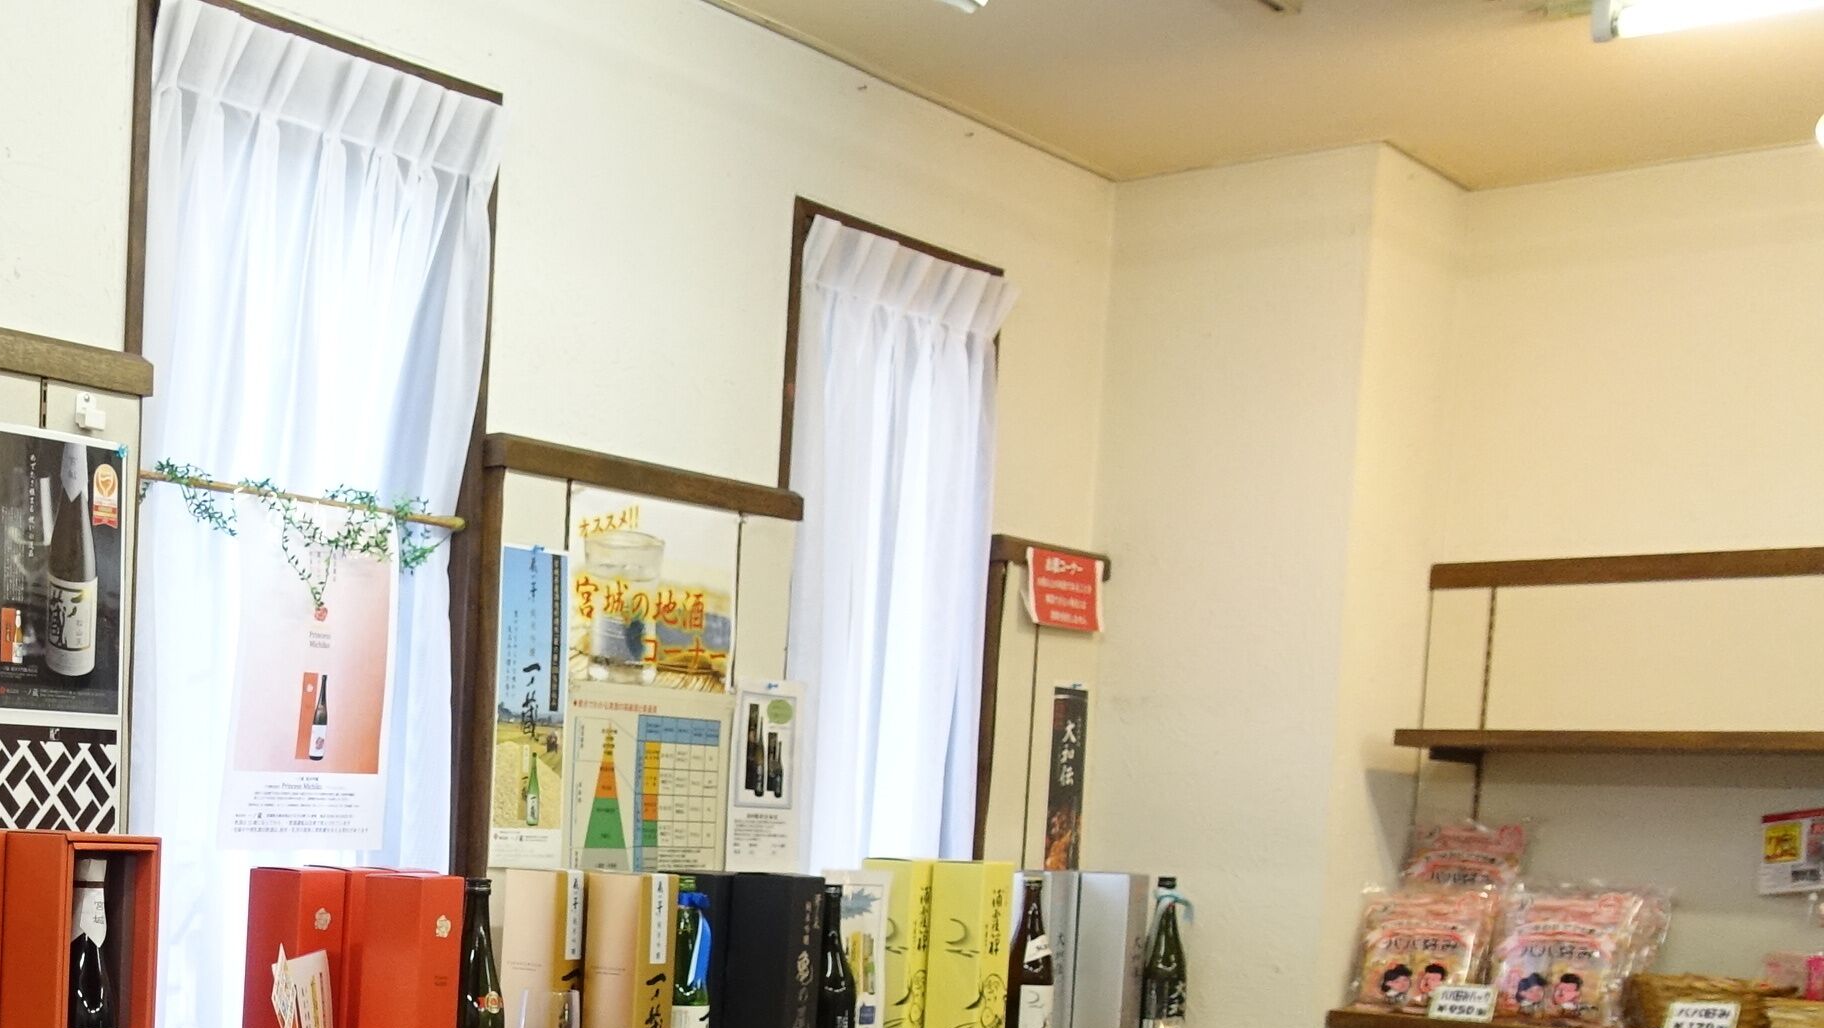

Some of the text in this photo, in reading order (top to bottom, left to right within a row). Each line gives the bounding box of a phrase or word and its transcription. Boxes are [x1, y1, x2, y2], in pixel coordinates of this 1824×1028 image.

[575, 577, 705, 629] 宮城の地酒
[642, 636, 728, 672] コーナー
[521, 662, 542, 743] 一ノ蔵
[1059, 719, 1077, 787] 大和伝
[1385, 938, 1459, 951] パパ好み
[1679, 1008, 1730, 1019] パパ好み
